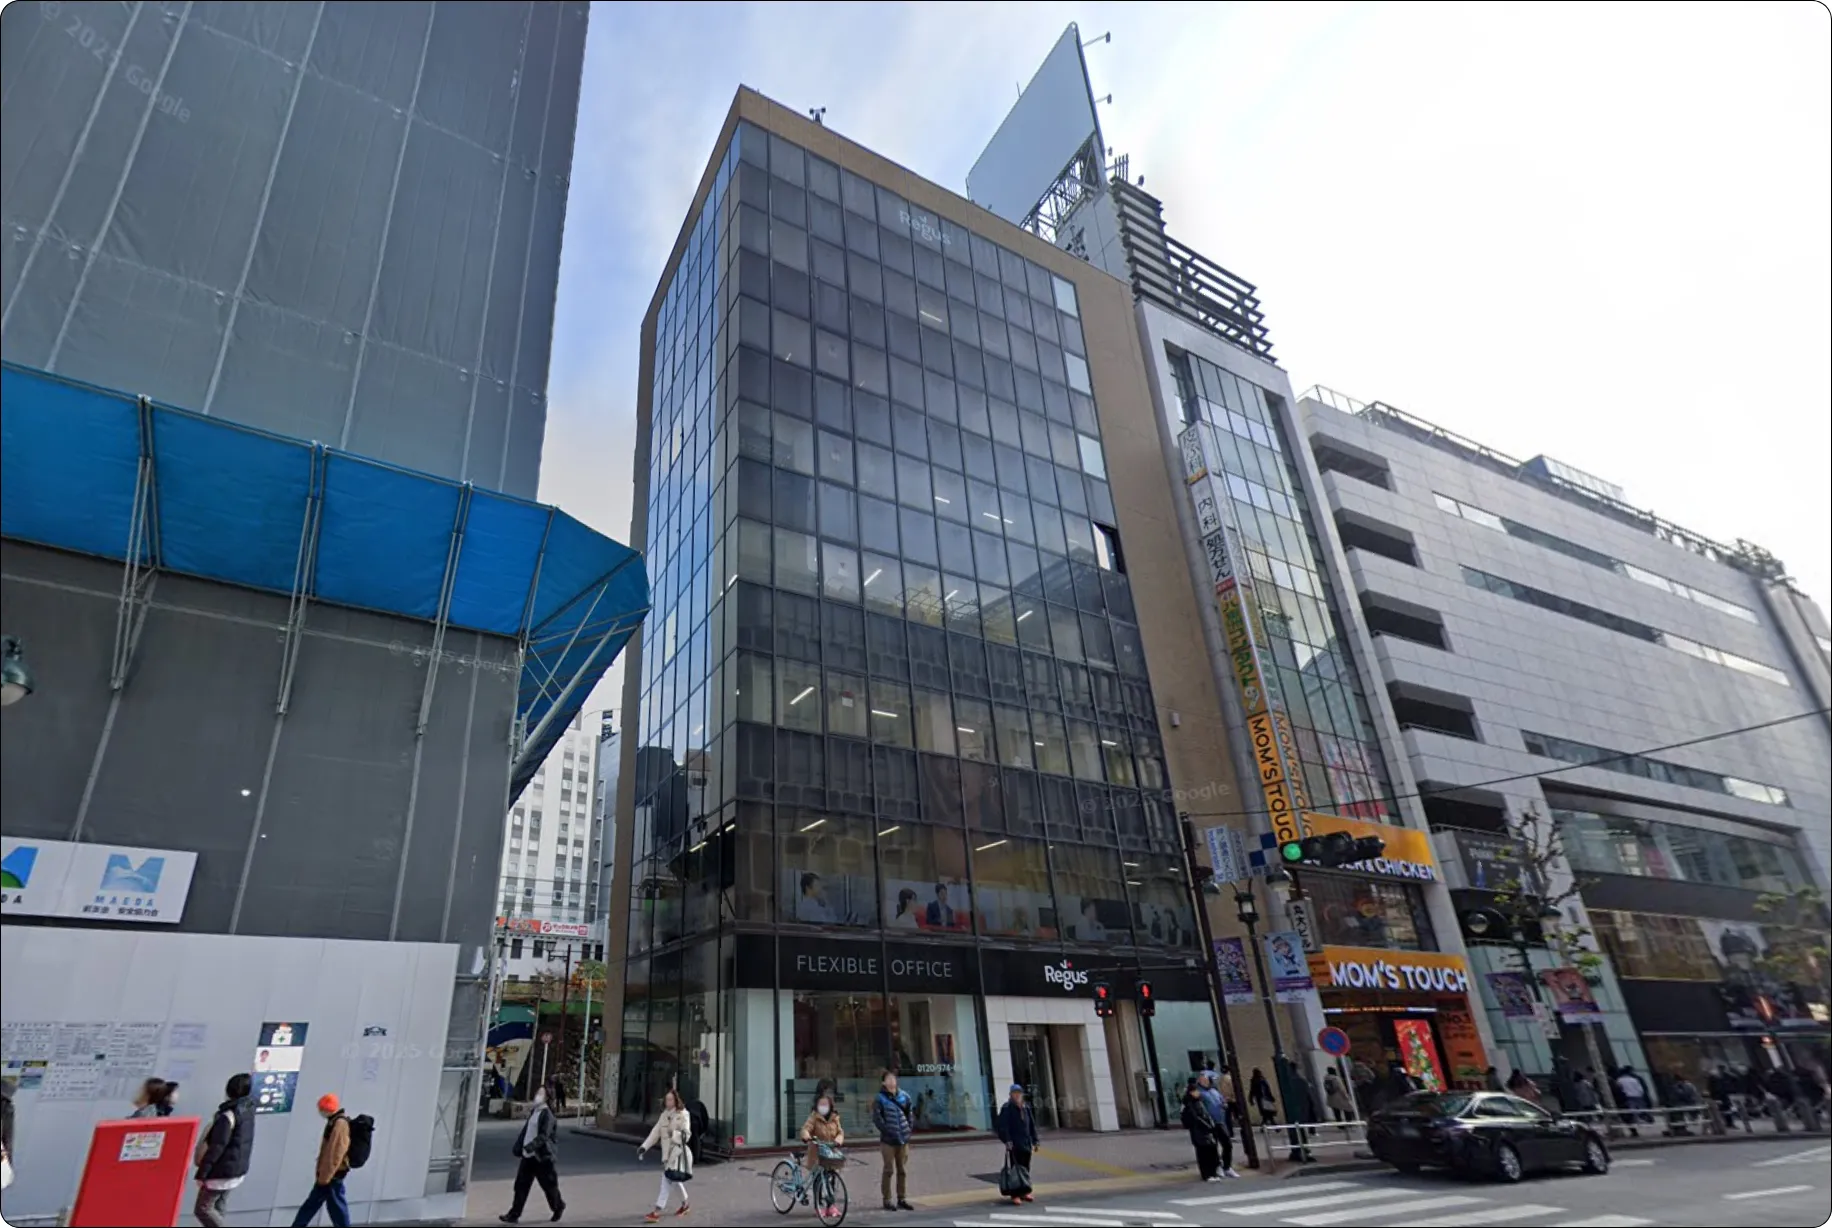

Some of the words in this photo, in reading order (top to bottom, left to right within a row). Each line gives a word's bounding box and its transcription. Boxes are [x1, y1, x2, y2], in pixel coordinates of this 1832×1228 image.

[900, 210, 951, 245] Regus
[1198, 497, 1217, 530] 内科
[1206, 534, 1231, 582] 処方せん
[1252, 718, 1278, 780] MOM'S
[1268, 785, 1293, 841] TOUC
[94, 895, 153, 907] MAEDA
[797, 954, 877, 975] FLEXIBLE
[891, 959, 952, 977] OFFICE
[1044, 962, 1088, 991] Regus
[1328, 959, 1400, 990] MOM'S
[1400, 965, 1470, 992] TOUCH
